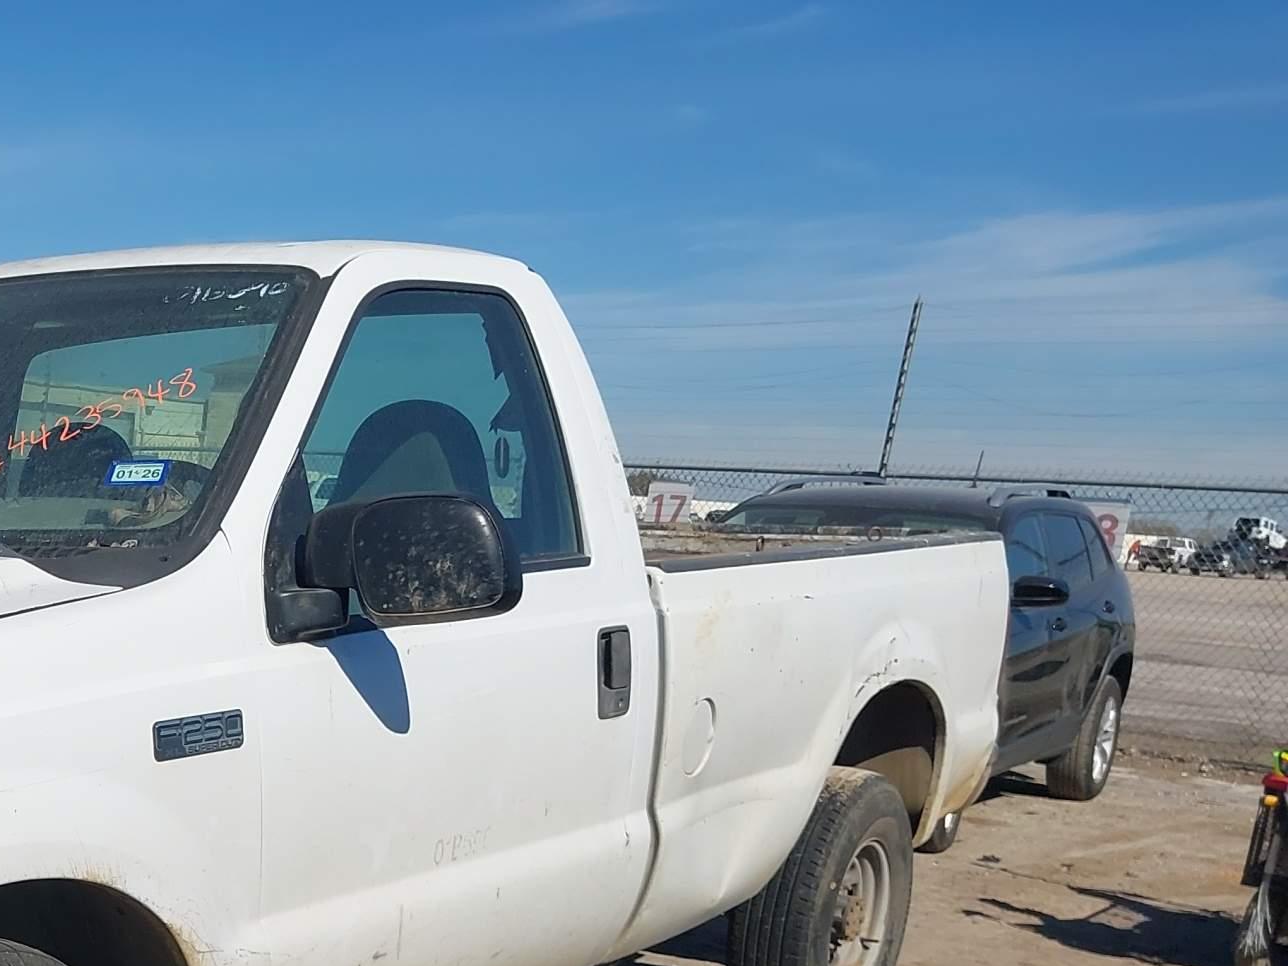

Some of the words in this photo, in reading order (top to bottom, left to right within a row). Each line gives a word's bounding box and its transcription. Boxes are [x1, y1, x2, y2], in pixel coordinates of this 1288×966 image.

[7, 368, 196, 456] 44235948
[116, 470, 133, 479] 01
[141, 469, 161, 478] 26
[652, 494, 687, 524] 17
